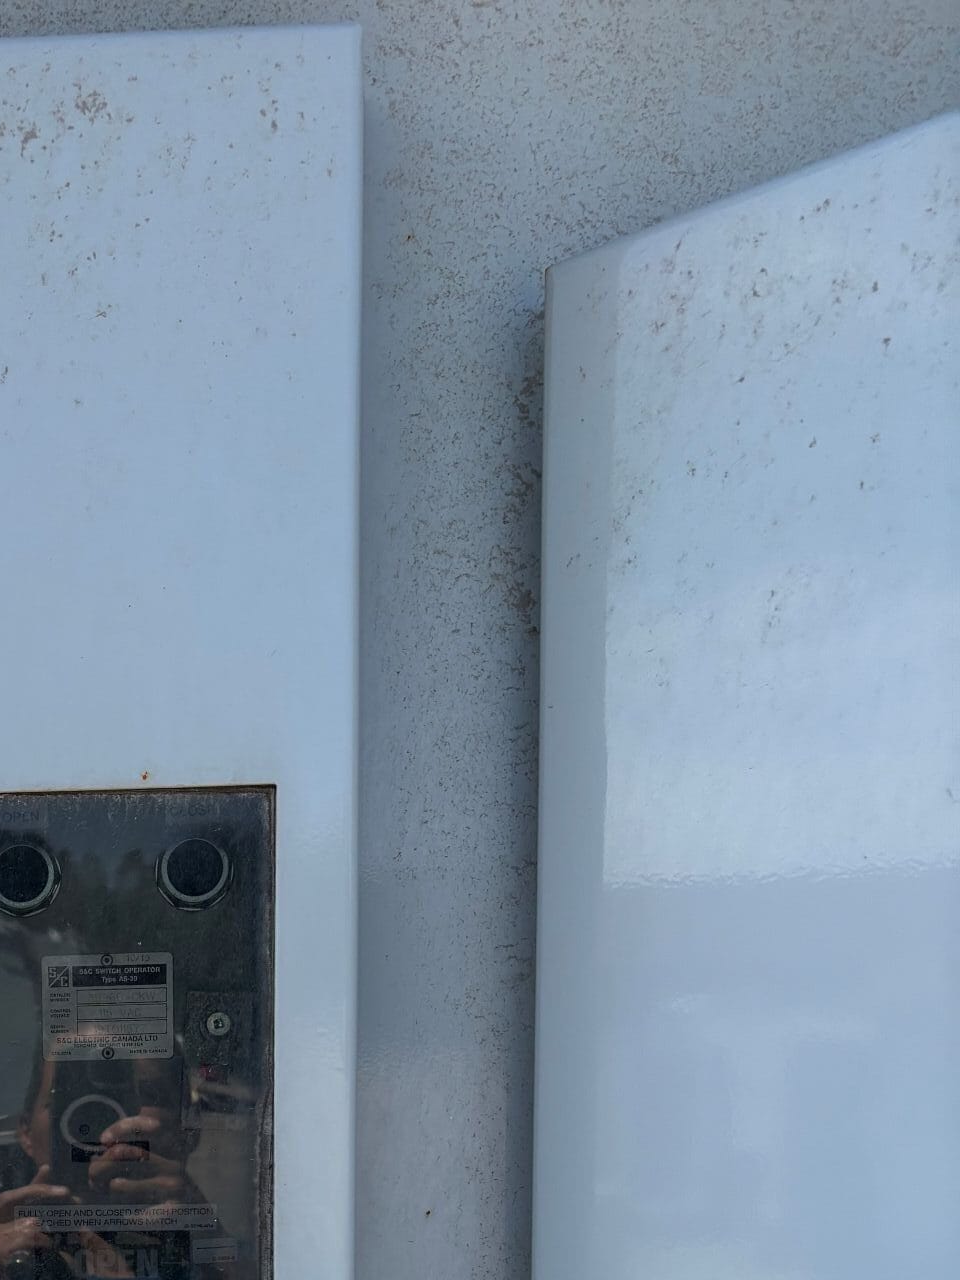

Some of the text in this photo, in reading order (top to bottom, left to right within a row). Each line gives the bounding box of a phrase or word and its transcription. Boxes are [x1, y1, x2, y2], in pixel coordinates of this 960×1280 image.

[1, 810, 40, 823] OPEN
[123, 966, 161, 974] OPERATOR
[56, 1034, 158, 1044] S&C ELECTRIC CANADA LTD
[18, 1207, 214, 1218] FULLY OPEN AND CLOSED SWITCH POSITION
[73, 1218, 101, 1227] WHEN
[103, 1217, 144, 1226] ARROWS
[145, 1217, 178, 1225] MATCH
[74, 1248, 159, 1278] OPEN
